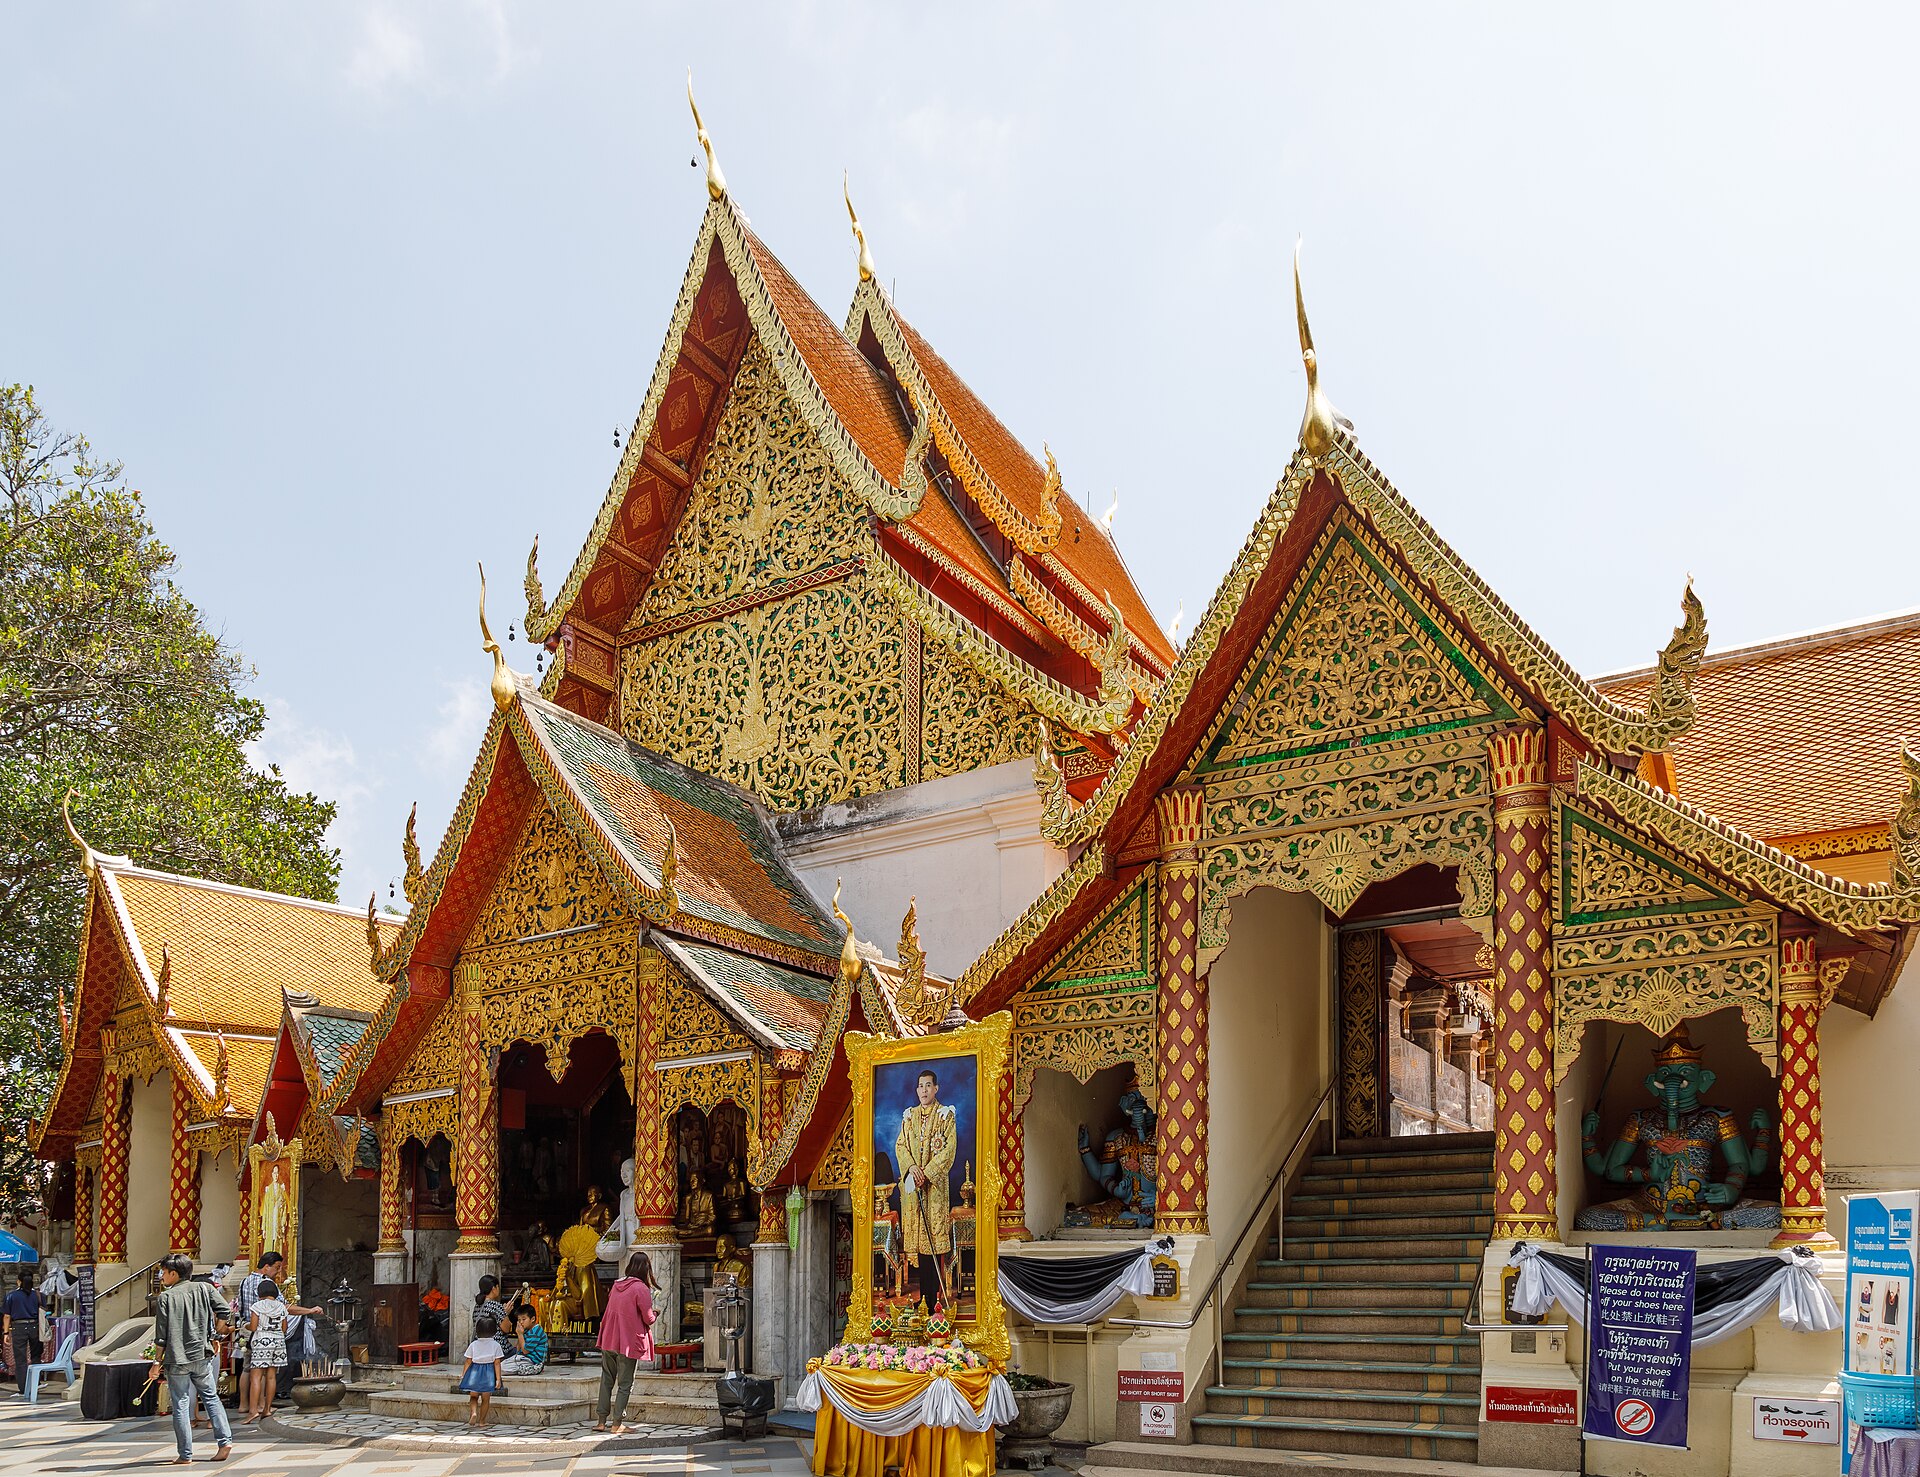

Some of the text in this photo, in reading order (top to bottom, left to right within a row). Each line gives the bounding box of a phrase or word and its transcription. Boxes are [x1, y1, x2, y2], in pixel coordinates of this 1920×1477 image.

[1604, 1255, 1680, 1272] กรุณาอย่าวาง
[1852, 1257, 1869, 1267] Please
[1599, 1271, 1689, 1288] รองเท้าบริเวณนี้
[1600, 1286, 1628, 1296] Please
[1630, 1289, 1641, 1297] do
[1644, 1290, 1659, 1298] not
[1600, 1296, 1685, 1311] off your shoes here.
[1609, 1330, 1669, 1349] ให้นำรองเท้า
[1608, 1362, 1671, 1376] Put your shoes
[1625, 1375, 1639, 1385] the
[1642, 1377, 1665, 1388] shelf.
[1488, 1400, 1575, 1414] ห้ามถอดรองเท้าบริเวณบันได
[1763, 1414, 1830, 1429] ที่วางรองเท้า
